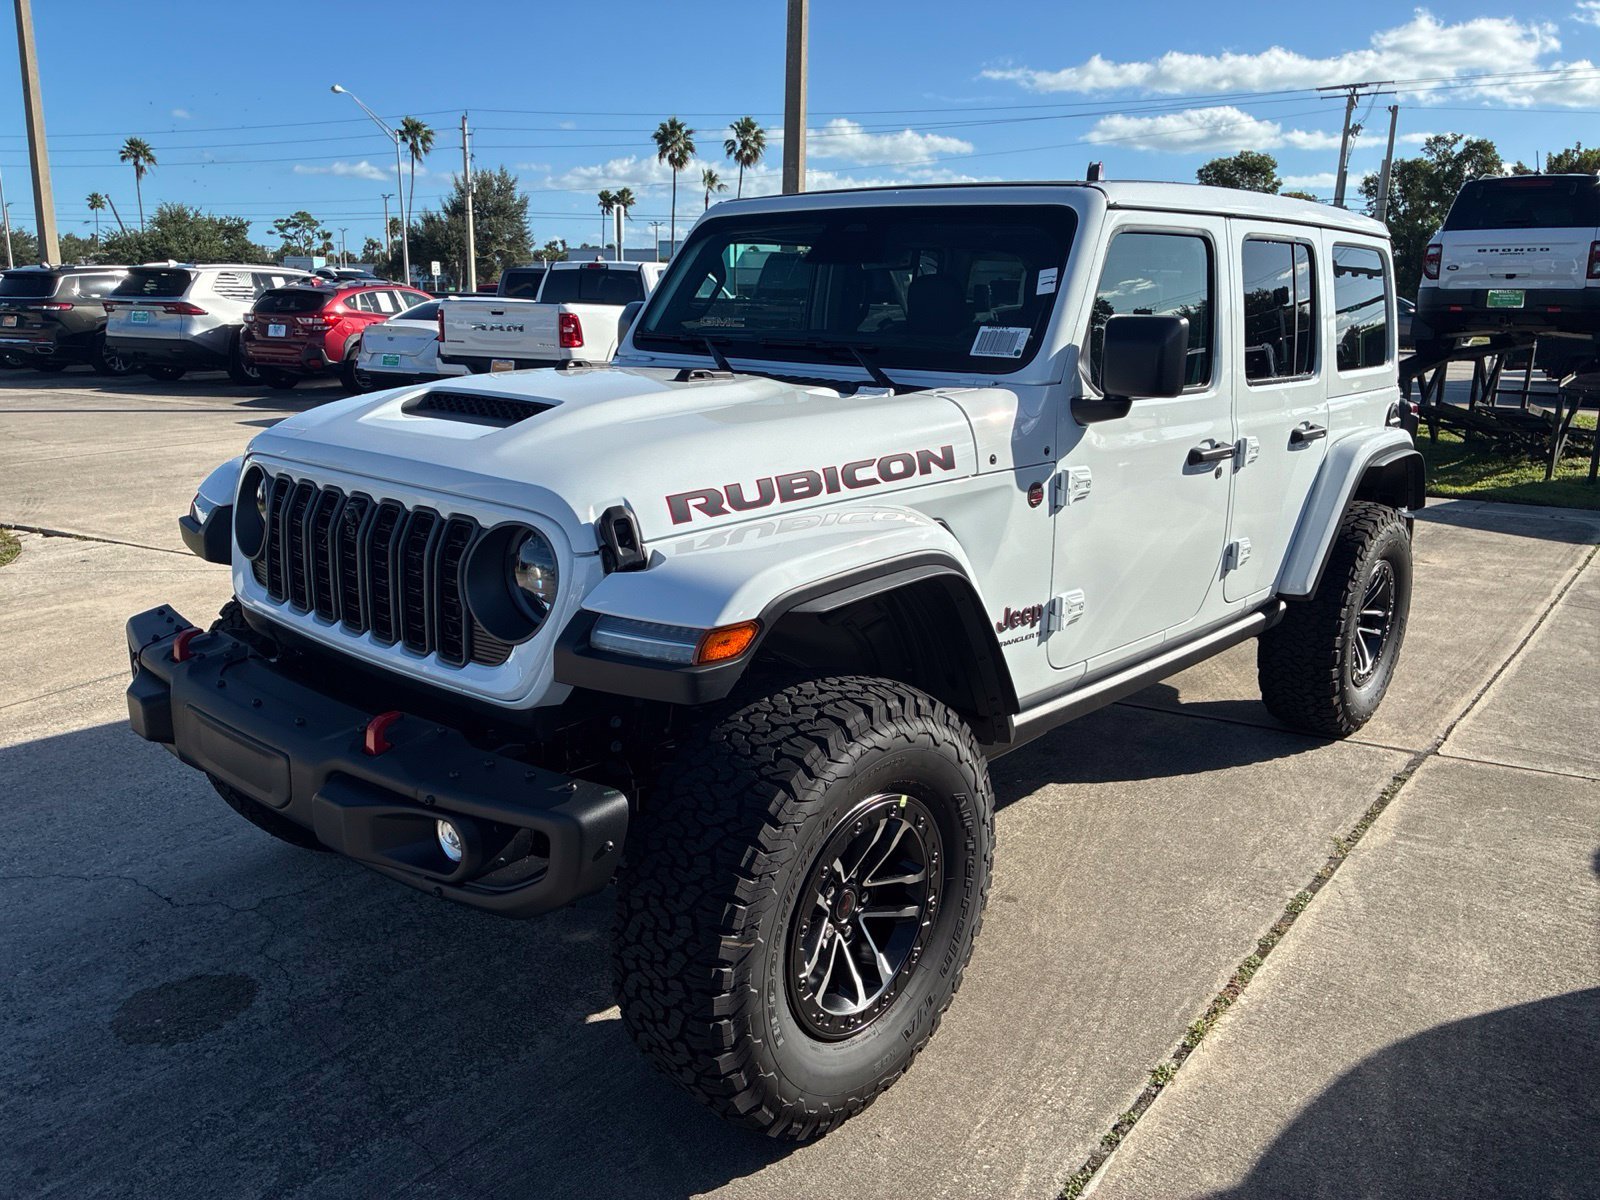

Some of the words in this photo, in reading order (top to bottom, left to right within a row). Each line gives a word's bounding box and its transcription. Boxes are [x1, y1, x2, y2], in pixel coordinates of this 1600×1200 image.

[471, 322, 525, 333] RAM
[700, 316, 745, 328] GMC
[664, 444, 957, 526] RUBICON
[995, 603, 1044, 634] Jeep
[999, 632, 1035, 647] RANGLER
